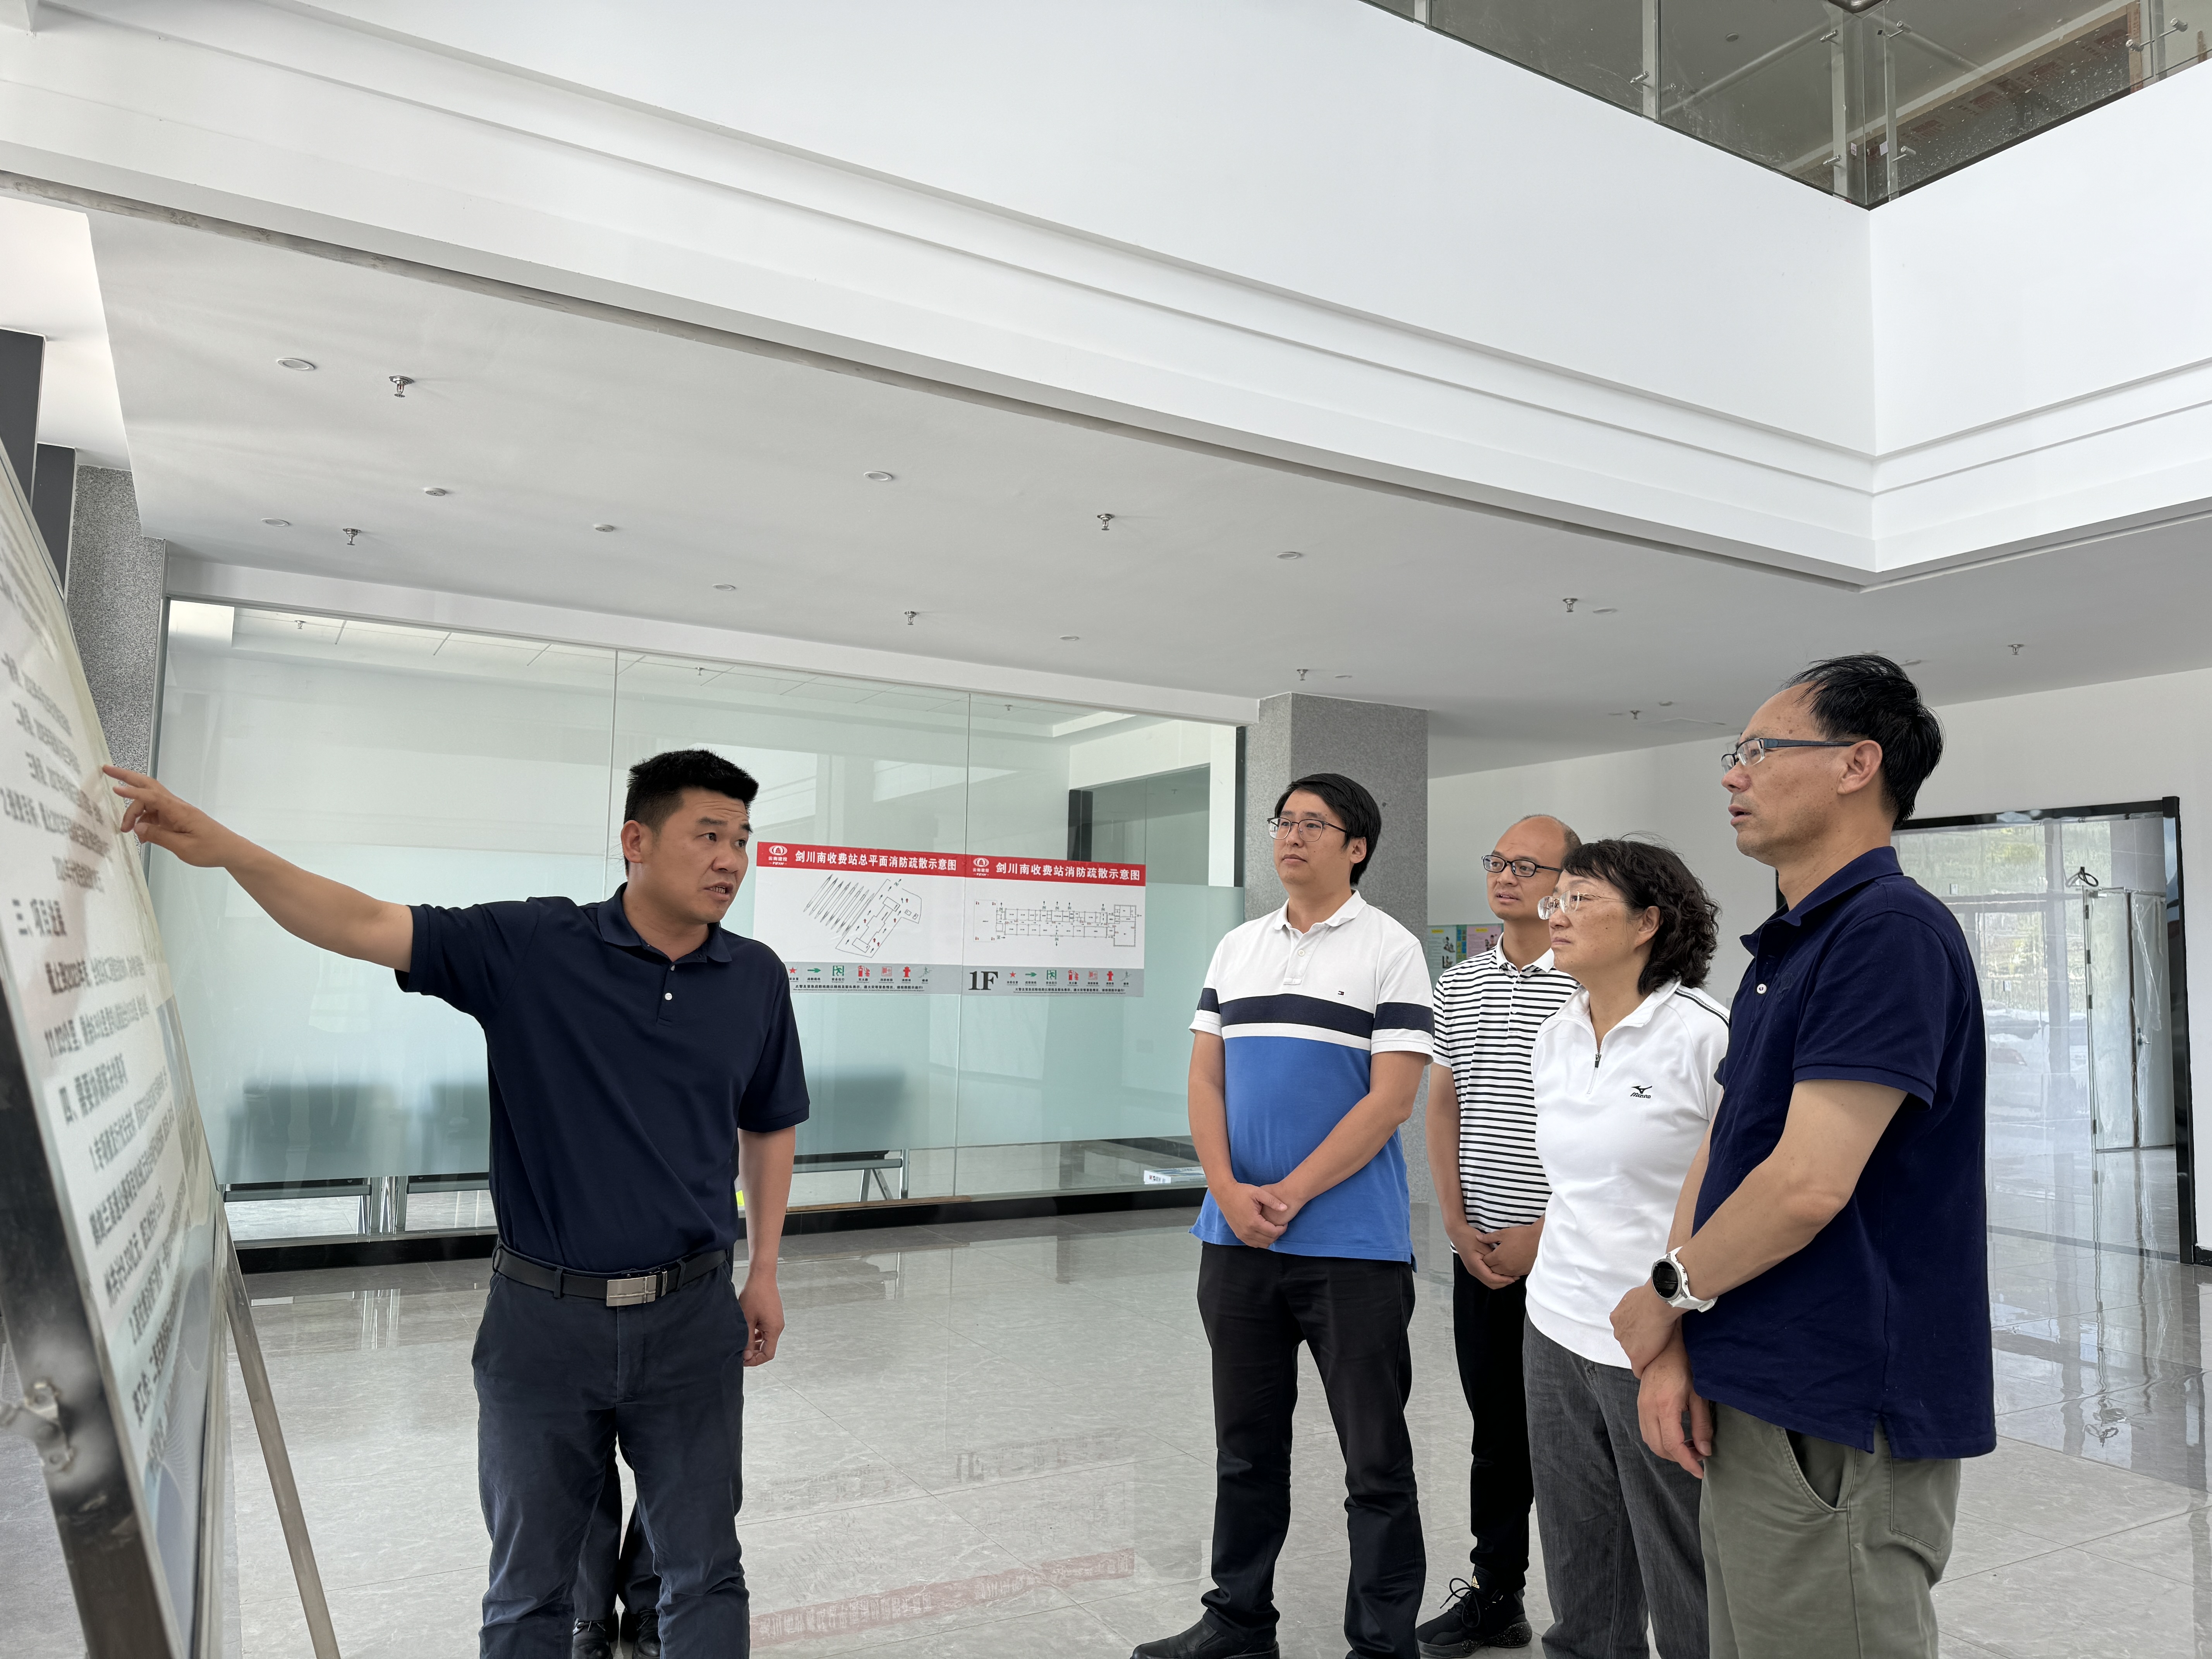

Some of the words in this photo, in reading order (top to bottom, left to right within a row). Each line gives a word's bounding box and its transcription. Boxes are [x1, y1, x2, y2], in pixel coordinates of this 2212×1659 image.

[795, 850, 957, 871] 剑川南收费站总平面消防疏散示意图
[996, 862, 1140, 881] 剑川南收费站消防疏散示意图
[969, 970, 998, 990] 1F
